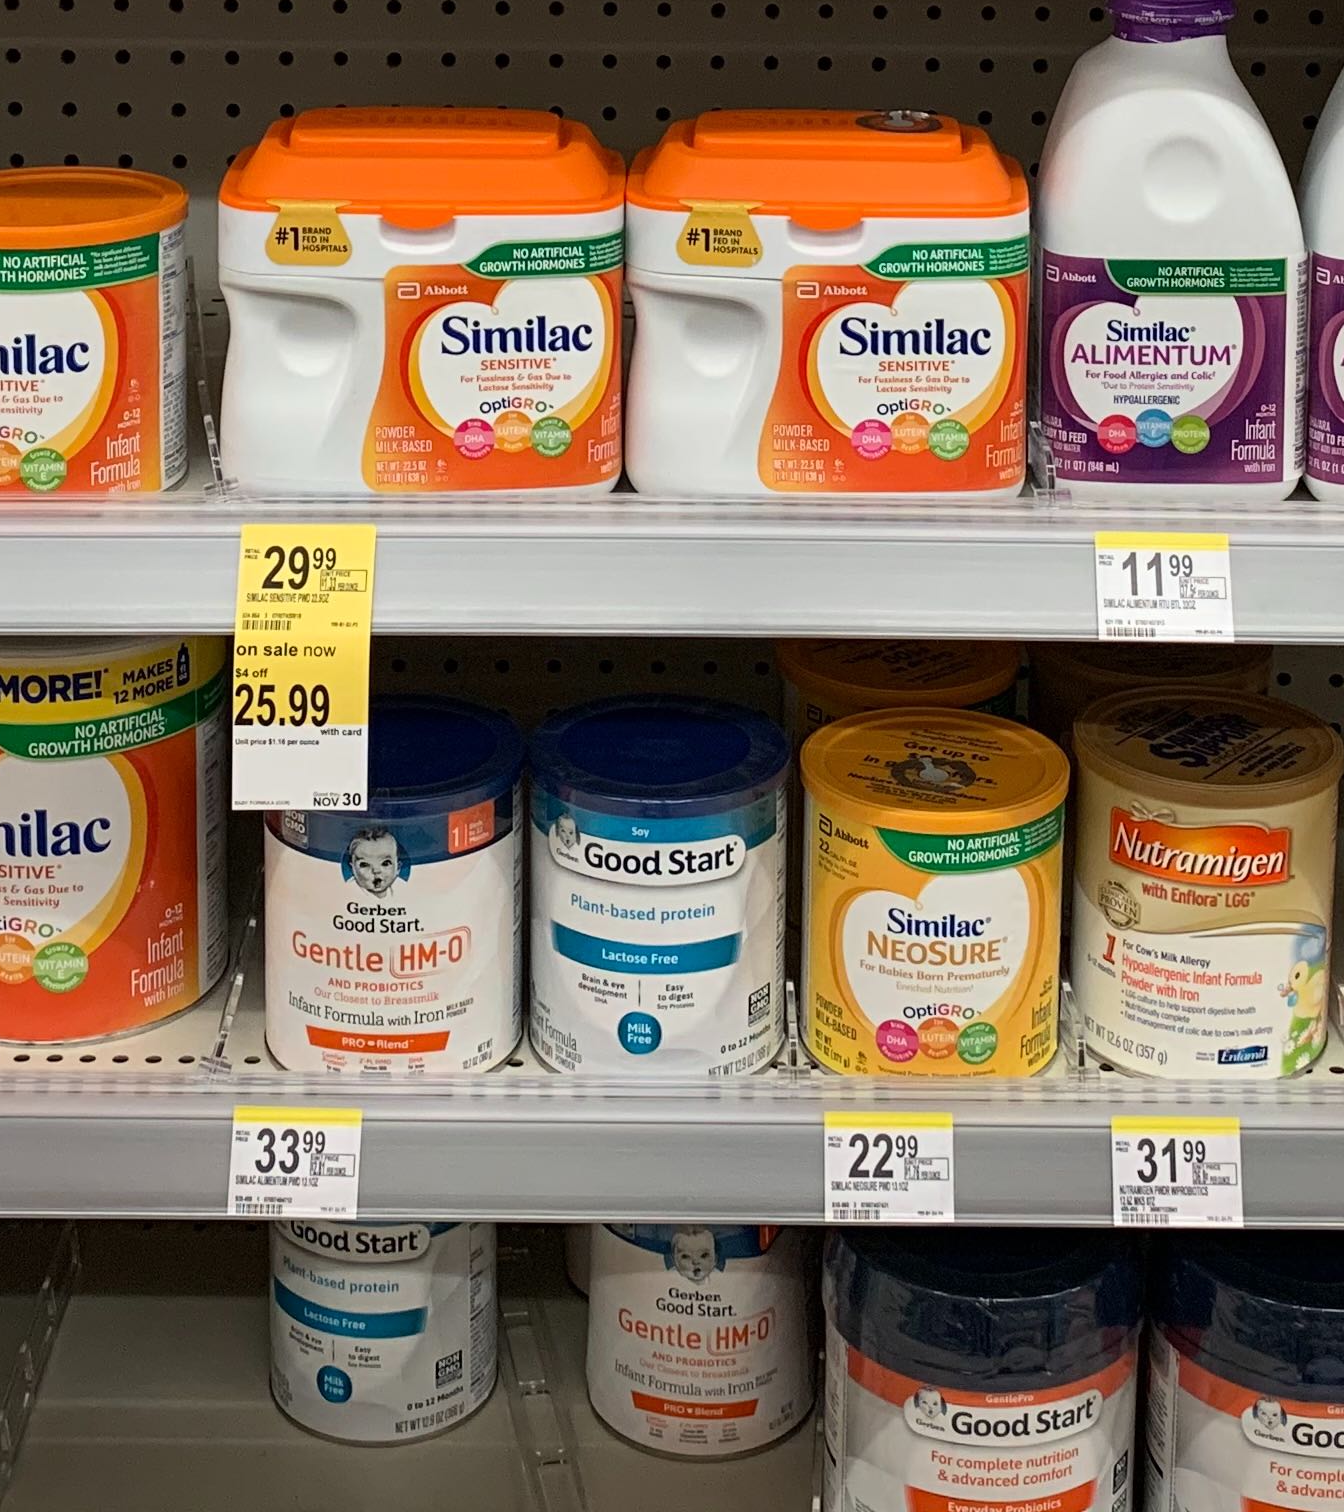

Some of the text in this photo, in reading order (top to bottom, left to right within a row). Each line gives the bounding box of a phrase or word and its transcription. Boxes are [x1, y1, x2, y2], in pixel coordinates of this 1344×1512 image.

[440, 317, 593, 357] Similac
[1107, 319, 1190, 344] Similac
[1072, 343, 1230, 367] ALIMENTUM
[234, 683, 330, 726] 25.99
[584, 843, 735, 876] Good Start
[1115, 830, 1285, 877] Nutramigen
[571, 894, 715, 923] Plant-based protein
[888, 909, 985, 936] Similac
[292, 931, 384, 972] Gentle
[602, 949, 679, 965] Lactose Free
